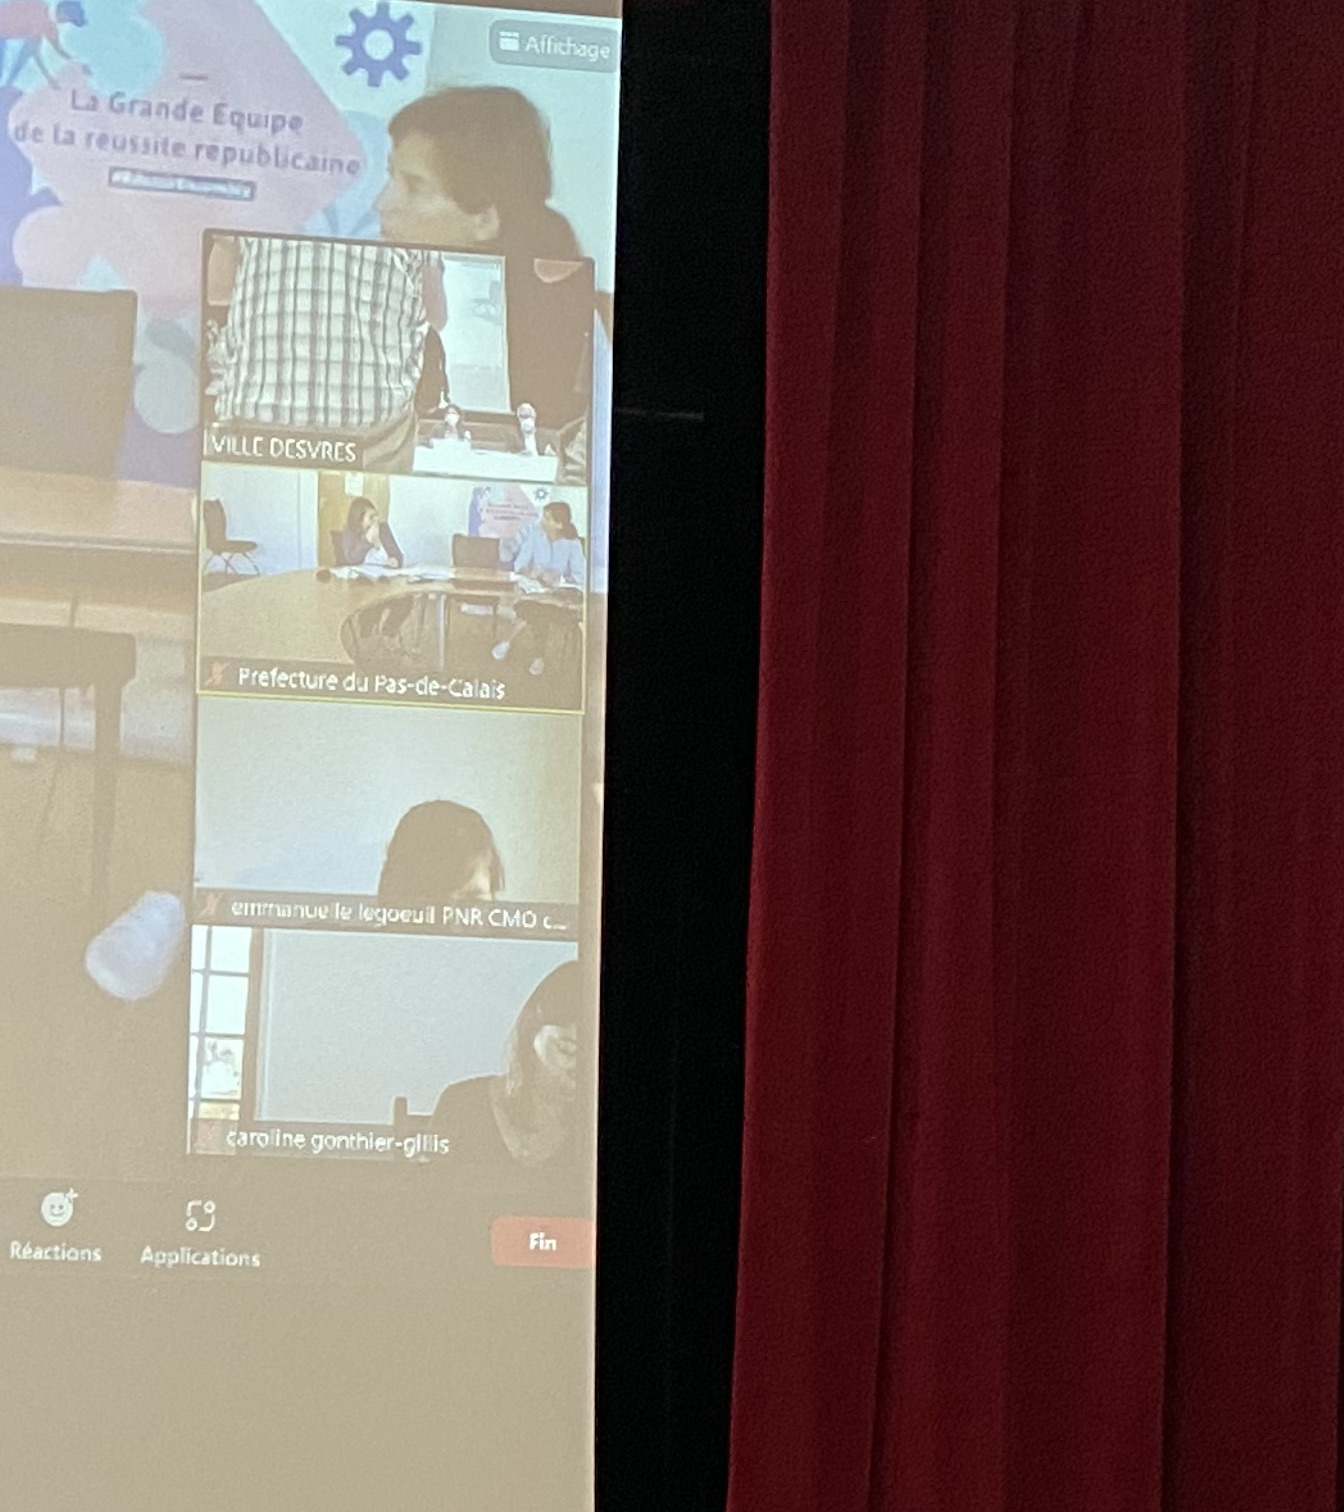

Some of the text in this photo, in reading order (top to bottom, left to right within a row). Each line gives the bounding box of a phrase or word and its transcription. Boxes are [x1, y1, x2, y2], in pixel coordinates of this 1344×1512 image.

[525, 34, 610, 62] Affichage
[70, 89, 98, 112] La
[108, 91, 205, 124] Grande
[12, 121, 44, 143] de
[52, 123, 76, 147] la
[212, 434, 357, 463] VILLE DESVRES
[342, 672, 369, 692] du
[374, 674, 506, 700] Pas-de-Calais
[442, 906, 484, 927] PNR
[488, 908, 537, 929] CMO
[226, 1128, 306, 1149] caroline
[10, 1239, 102, 1263] Réactions
[528, 1232, 558, 1252] Fin
[140, 1245, 261, 1269] Applications
